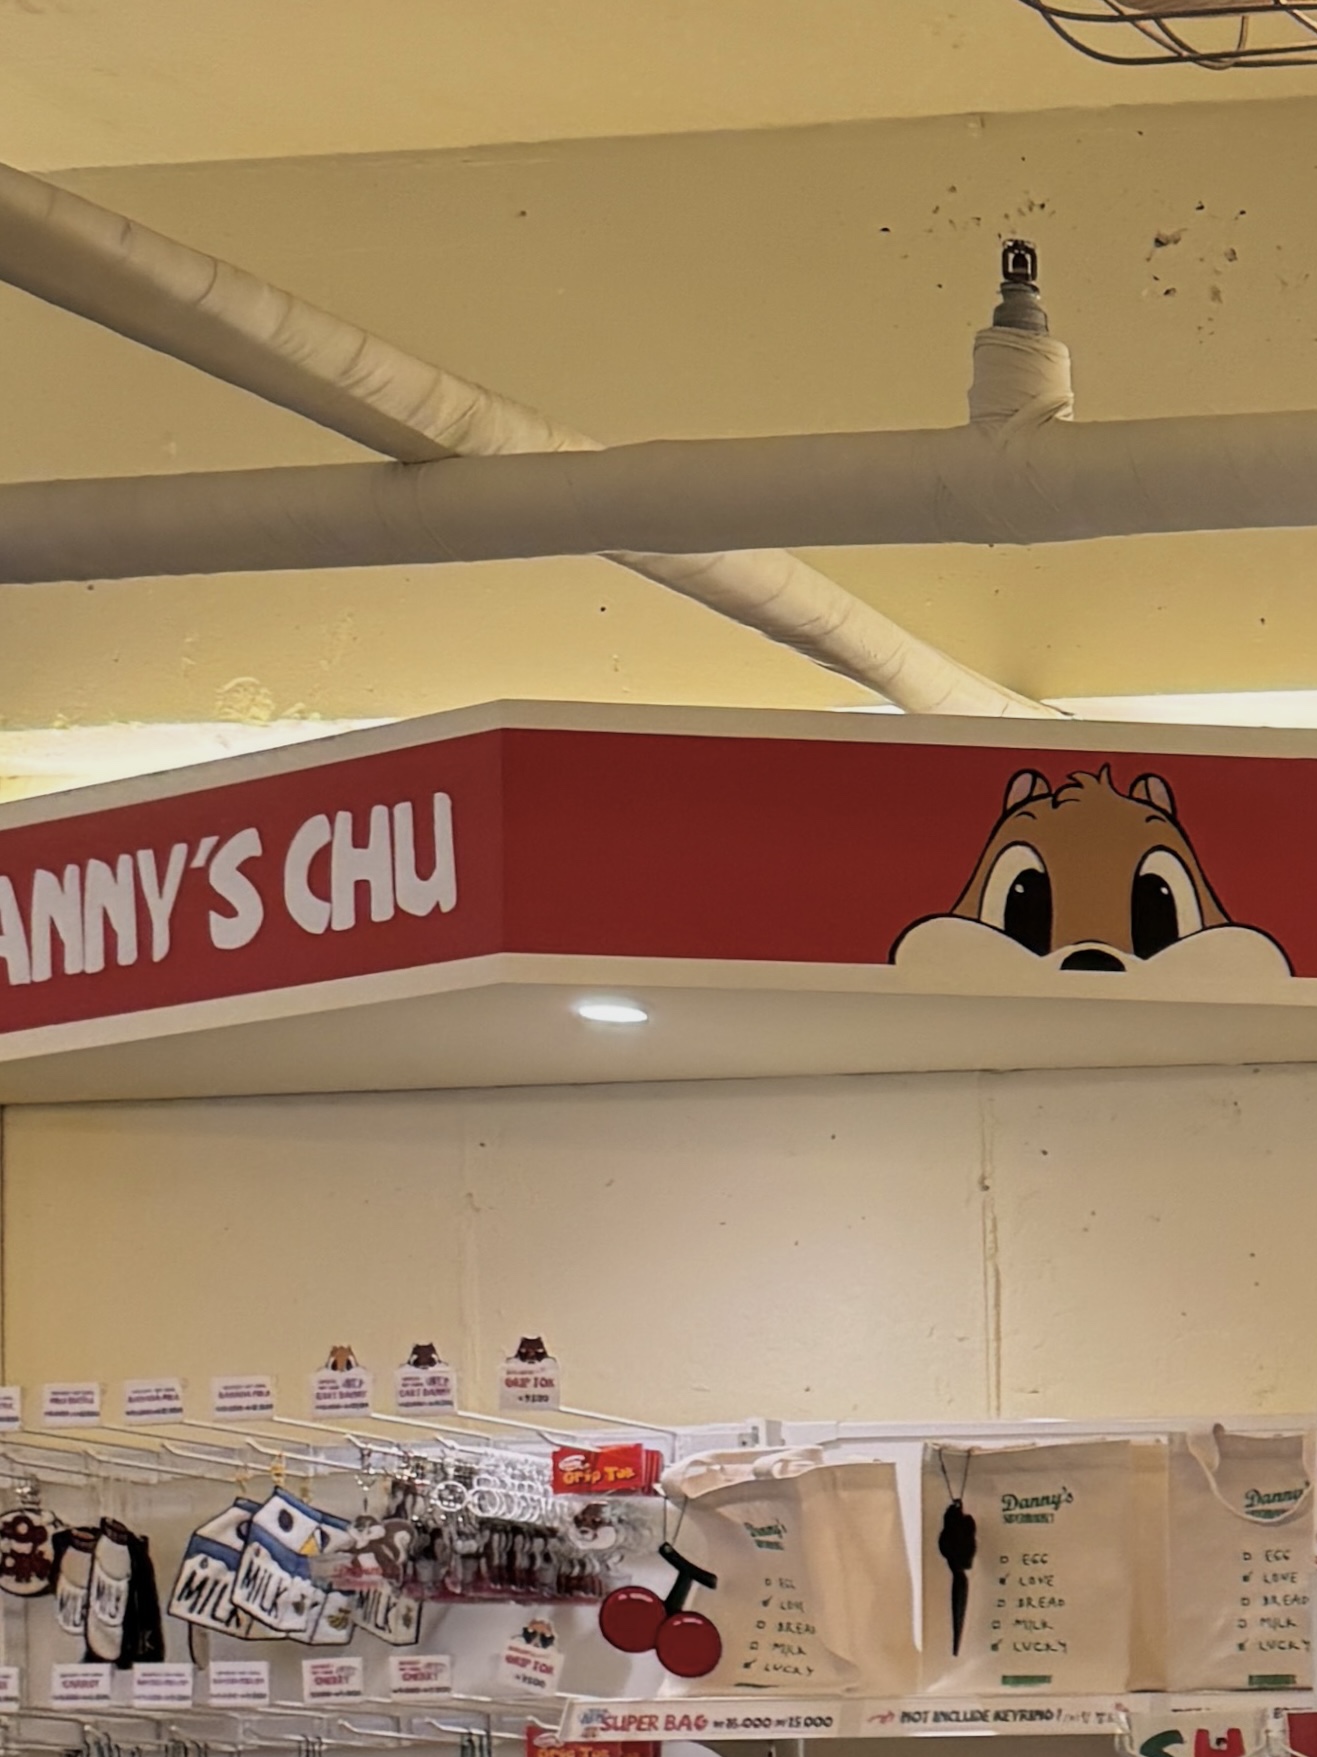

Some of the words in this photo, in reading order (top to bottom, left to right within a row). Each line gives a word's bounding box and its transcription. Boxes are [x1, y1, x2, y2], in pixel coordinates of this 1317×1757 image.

[284, 792, 455, 934] CHU
[562, 1467, 601, 1486] Grip
[1001, 1487, 1074, 1513] Danny's
[1019, 1574, 1055, 1587] LOVE
[1262, 1571, 1297, 1584] LOVE
[1016, 1596, 1066, 1609] BREAD
[1014, 1618, 1054, 1631] MILK
[1259, 1617, 1297, 1629] MILK
[1013, 1640, 1069, 1654] LUCKY
[1258, 1638, 1312, 1653] LUCKY
[600, 1714, 658, 1732] SUPER
[664, 1714, 708, 1731] BAG
[900, 1711, 929, 1724] NOT
